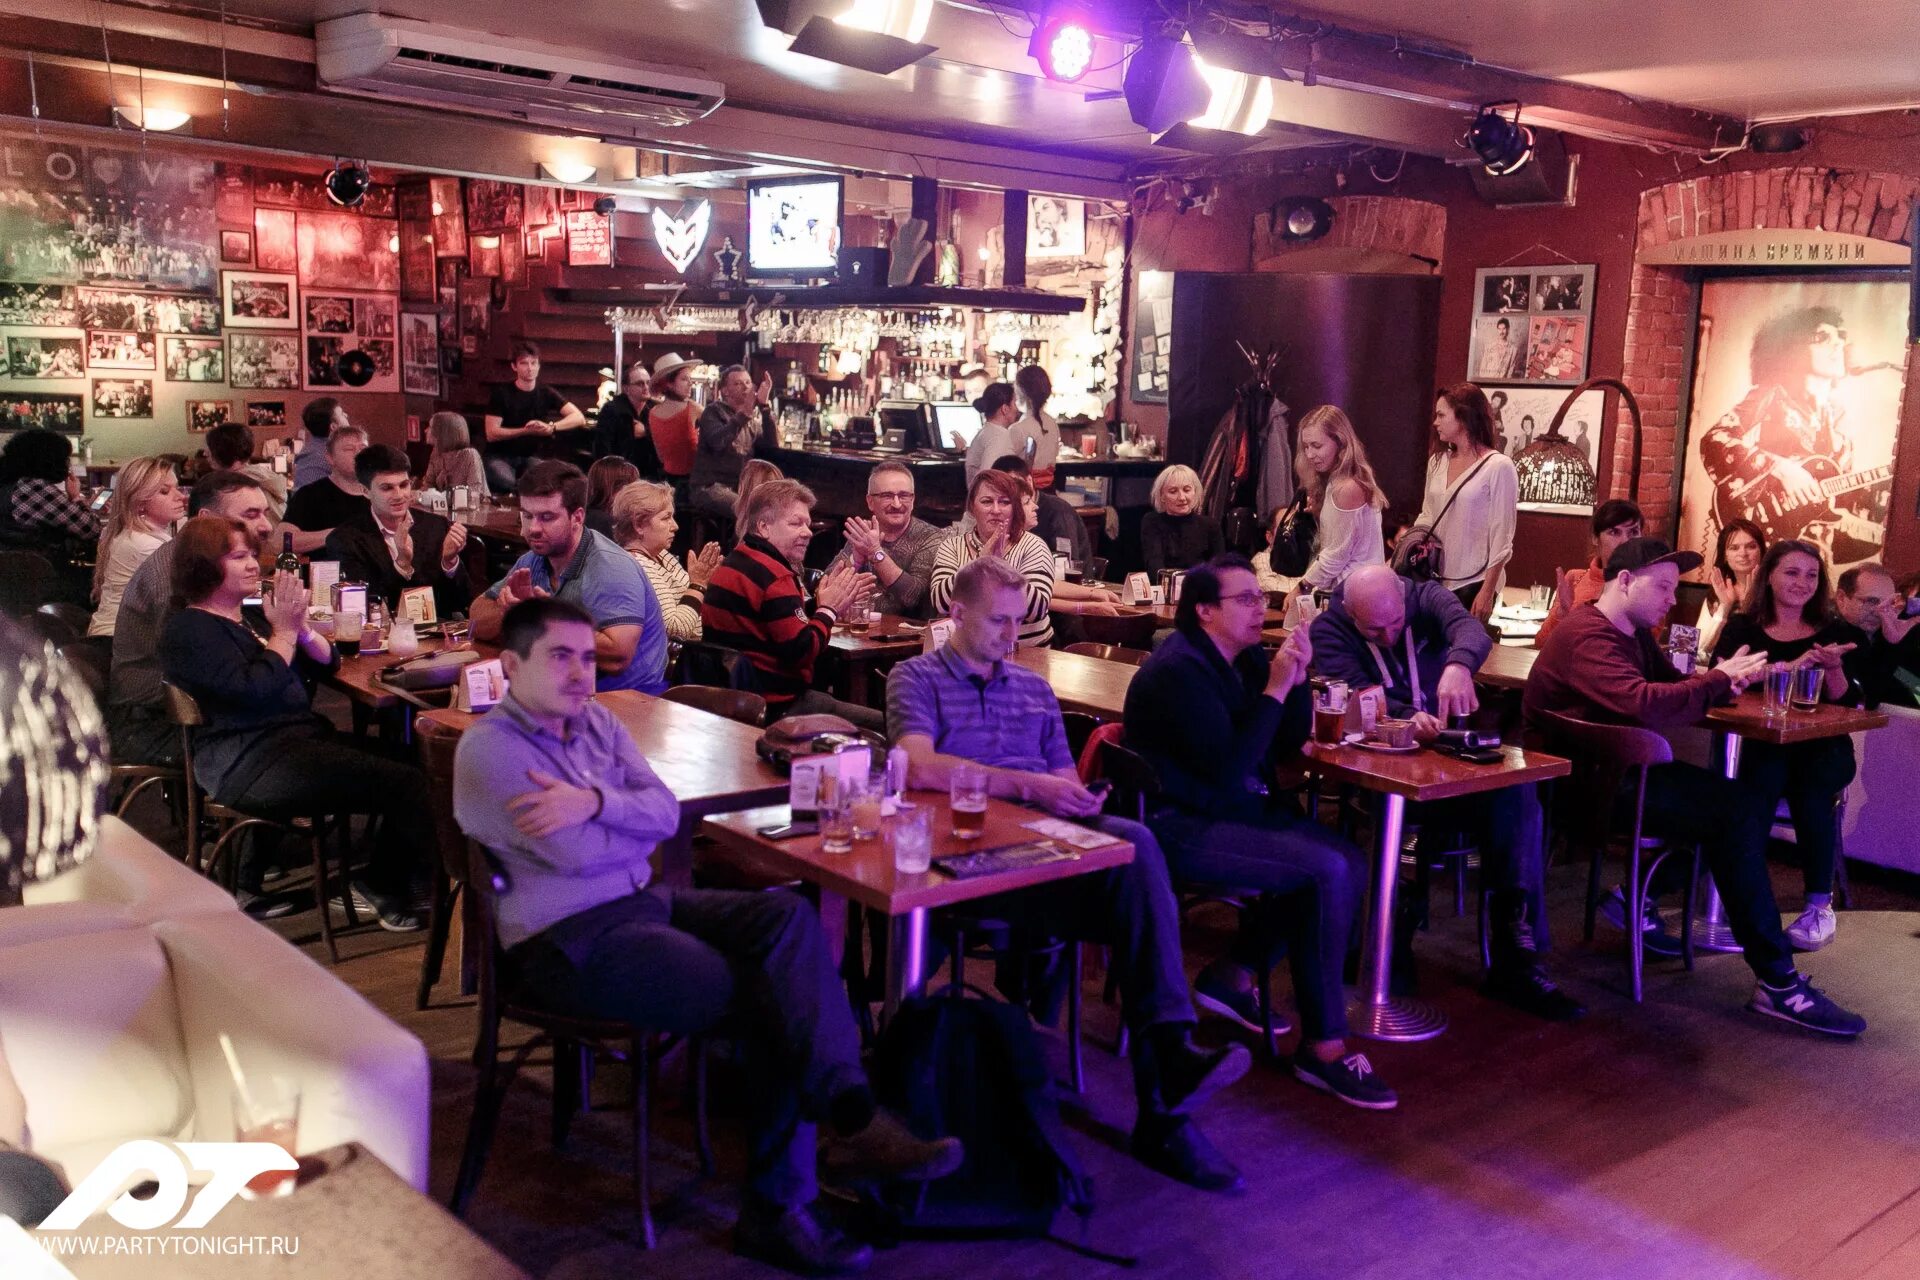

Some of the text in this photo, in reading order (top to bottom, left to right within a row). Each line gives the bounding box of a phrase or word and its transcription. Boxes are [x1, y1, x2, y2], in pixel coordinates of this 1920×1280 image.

[1767, 242, 1866, 261] ВРЕМЕНИ
[434, 500, 446, 509] 16
[1153, 590, 1159, 601] 7
[1784, 994, 1815, 1013] N
